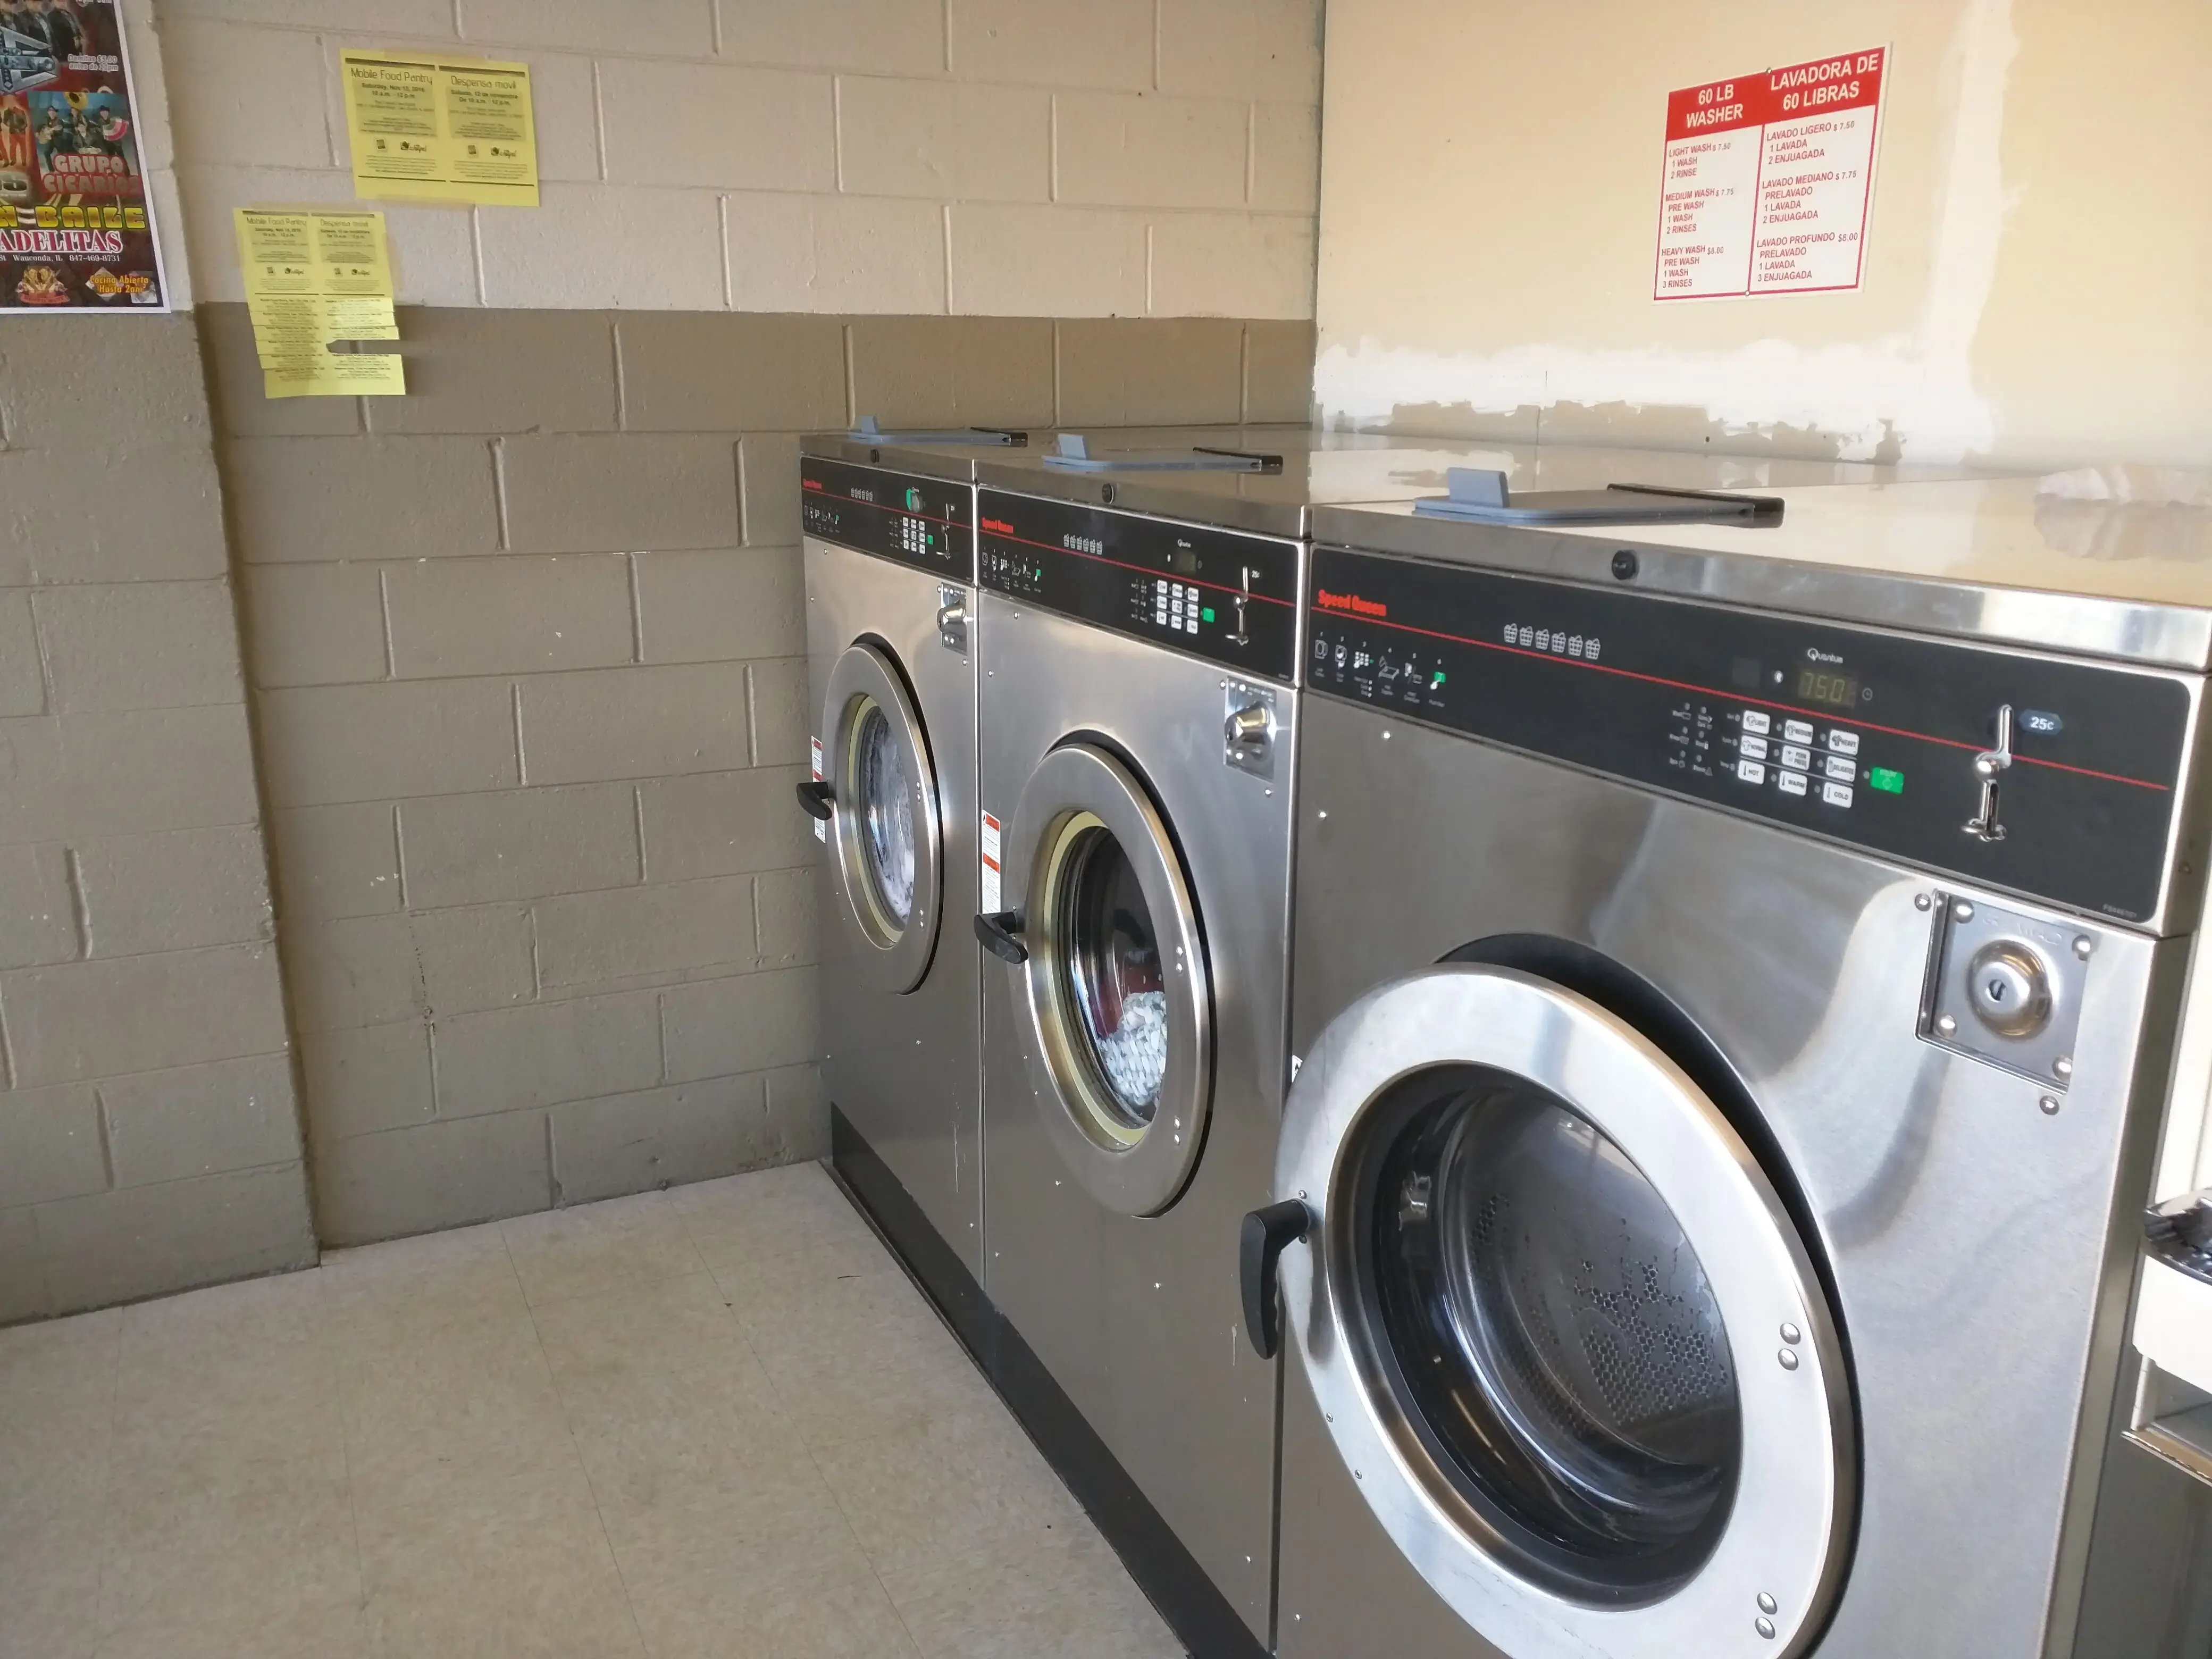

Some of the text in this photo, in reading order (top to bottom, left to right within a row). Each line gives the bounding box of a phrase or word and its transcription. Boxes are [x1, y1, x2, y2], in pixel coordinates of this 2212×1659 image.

[351, 68, 433, 85] Mobile Food Pantry
[1771, 53, 1880, 91] LAVADORA DE
[451, 75, 492, 89] Despensa
[1698, 83, 1735, 105] 60 LB
[1782, 80, 1860, 111] 60 LIBRAS
[1686, 103, 1744, 129] WASHER
[1766, 128, 1798, 141] LAVADO
[1800, 122, 1831, 136] LIGERO
[1840, 120, 1855, 130] 7.50
[1669, 146, 1689, 158] LIGHT
[1691, 143, 1712, 154] WASH
[1718, 142, 1731, 150] 7.50
[1770, 138, 1807, 153] 1 LAVADA
[1677, 156, 1698, 167] WASH
[1768, 148, 1825, 165] 2 ENJUAGADA
[55, 155, 124, 173] GRUPO
[1670, 167, 1697, 180] 2 RINSE
[1762, 176, 1794, 189] LAVADO
[1795, 171, 1834, 185] MEDIANO
[1842, 170, 1857, 180] 7.75
[1665, 190, 1693, 202] MEDIUM
[1694, 188, 1715, 198] WASH
[1765, 186, 1813, 200] PRELAVADO
[1669, 200, 1705, 212] PRE WASH
[1764, 199, 1802, 212] 1 LAVADA
[35, 206, 146, 229] BAILE
[1673, 213, 1694, 223] WASH
[1763, 210, 1819, 224] 2 ENJUAGADA
[1666, 223, 1697, 234] 2 RINSES
[1757, 232, 1858, 248] LAVADO PROFUNDO $8.00
[1662, 246, 1684, 256] HEAVY
[1685, 245, 1706, 255] WASH
[1759, 247, 1807, 259] PRELAVADO
[1664, 257, 1700, 267] PRE WASH
[1765, 259, 1795, 270] LAVADA
[90, 275, 116, 283] Cocina
[1669, 268, 1689, 278] WASH
[1757, 270, 1813, 282] 3 ENJUAGADA
[99, 284, 122, 293] Hasta
[1668, 278, 1693, 288] RINSES
[1318, 589, 1387, 617] Speed Queen
[1833, 791, 1849, 801] COLD
